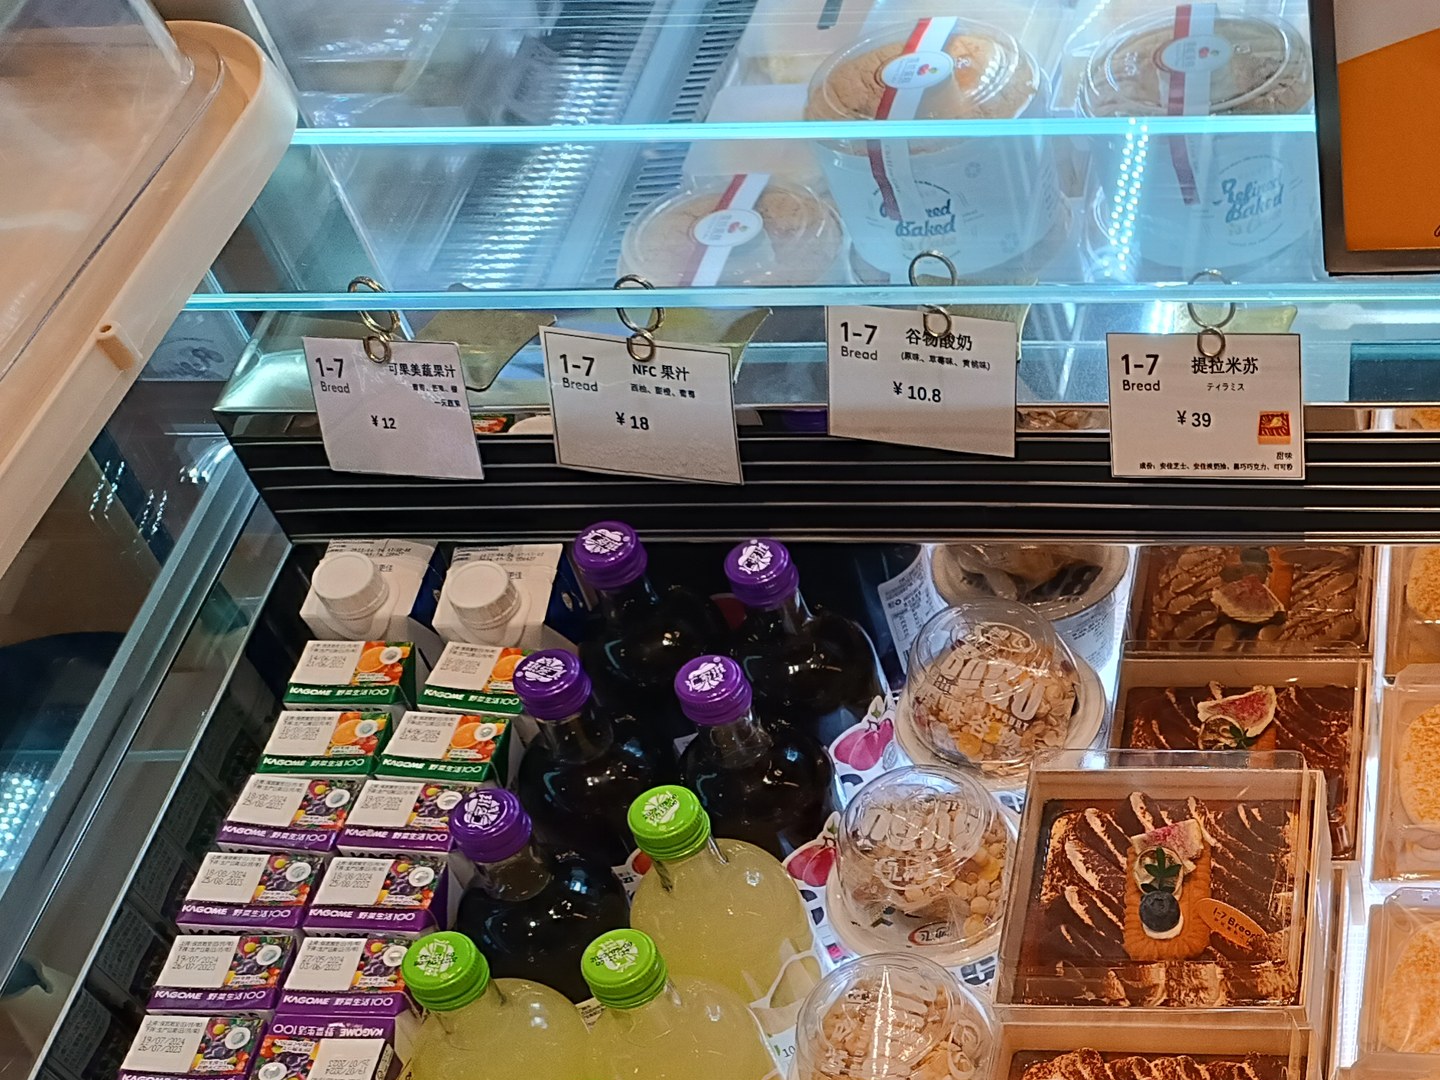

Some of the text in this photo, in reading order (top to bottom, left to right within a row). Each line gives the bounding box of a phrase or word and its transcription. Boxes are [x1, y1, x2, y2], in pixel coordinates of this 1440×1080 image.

[840, 322, 878, 345] 1-7
[841, 346, 878, 361] Bread
[315, 358, 344, 378] 1-7
[559, 354, 595, 377] 1-7
[1121, 354, 1159, 375] 1-7
[1191, 357, 1259, 374] 提拉米苏
[632, 364, 690, 382] NFC 果汁
[320, 381, 350, 393] Bread
[562, 377, 599, 392] Bread
[1122, 380, 1161, 391] Bread
[222, 825, 266, 837] KAGOME
[345, 828, 388, 838] KAGOME
[182, 905, 227, 916] KAGOME
[308, 908, 353, 919] KAGOME
[155, 990, 203, 1000] KAGOME
[283, 995, 330, 1006] KAGOME
